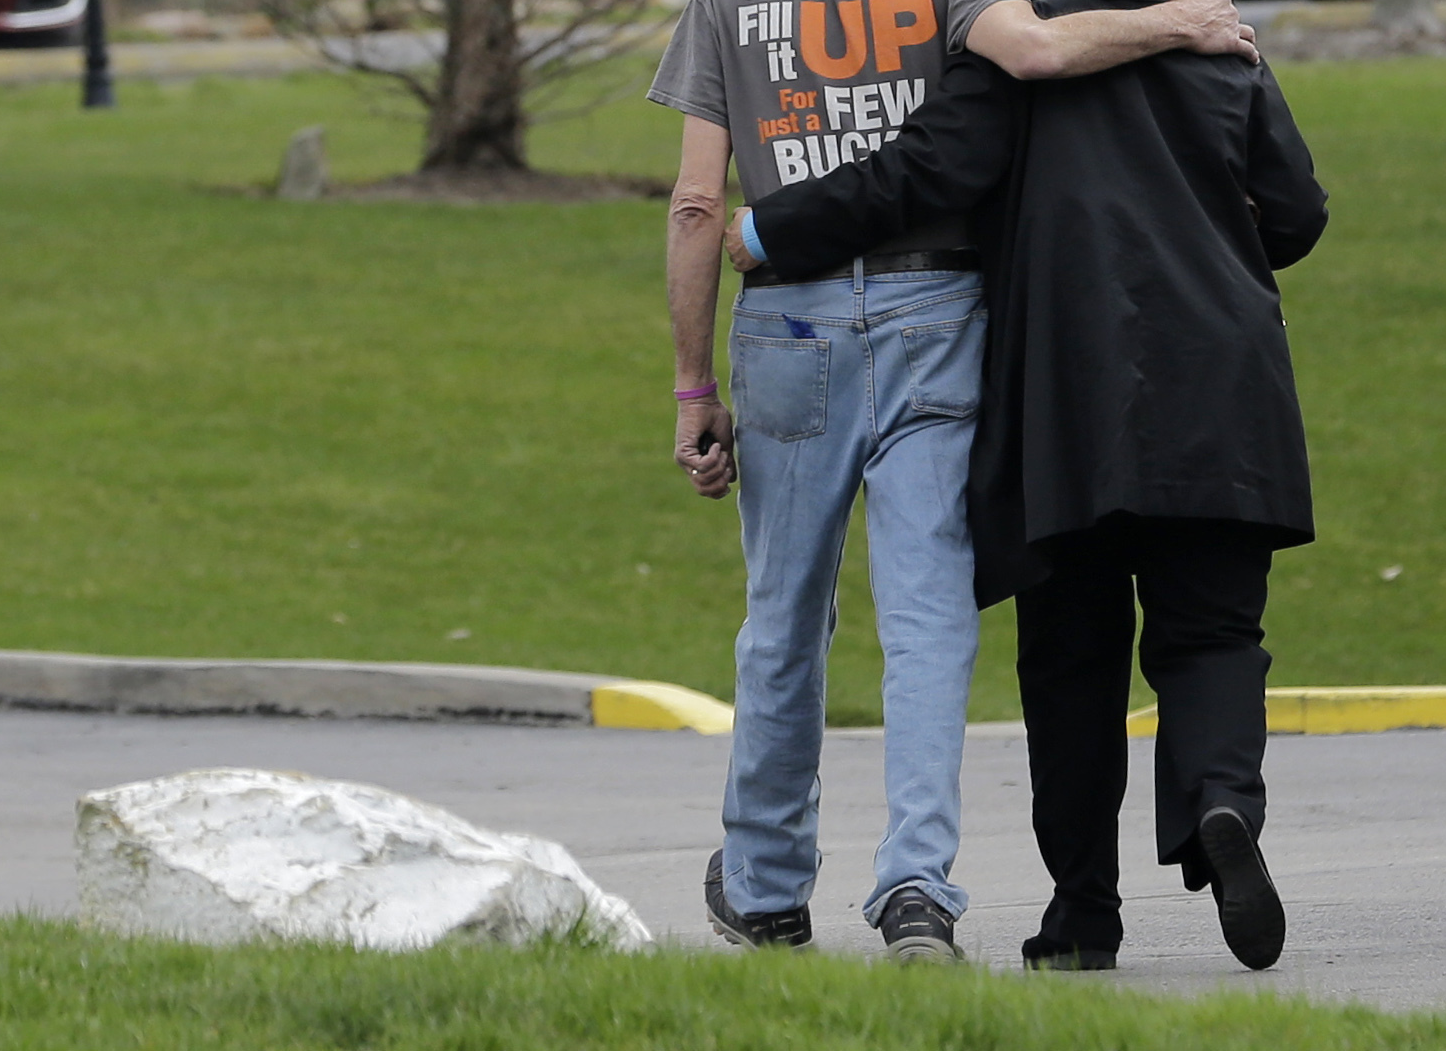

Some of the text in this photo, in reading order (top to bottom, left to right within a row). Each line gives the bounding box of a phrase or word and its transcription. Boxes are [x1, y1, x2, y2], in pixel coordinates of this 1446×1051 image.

[738, 1, 793, 46] Fill
[767, 42, 798, 82] it
[779, 88, 818, 111] For
[824, 78, 925, 130] FEW
[758, 112, 821, 144] just a
[772, 130, 900, 186] BUC
